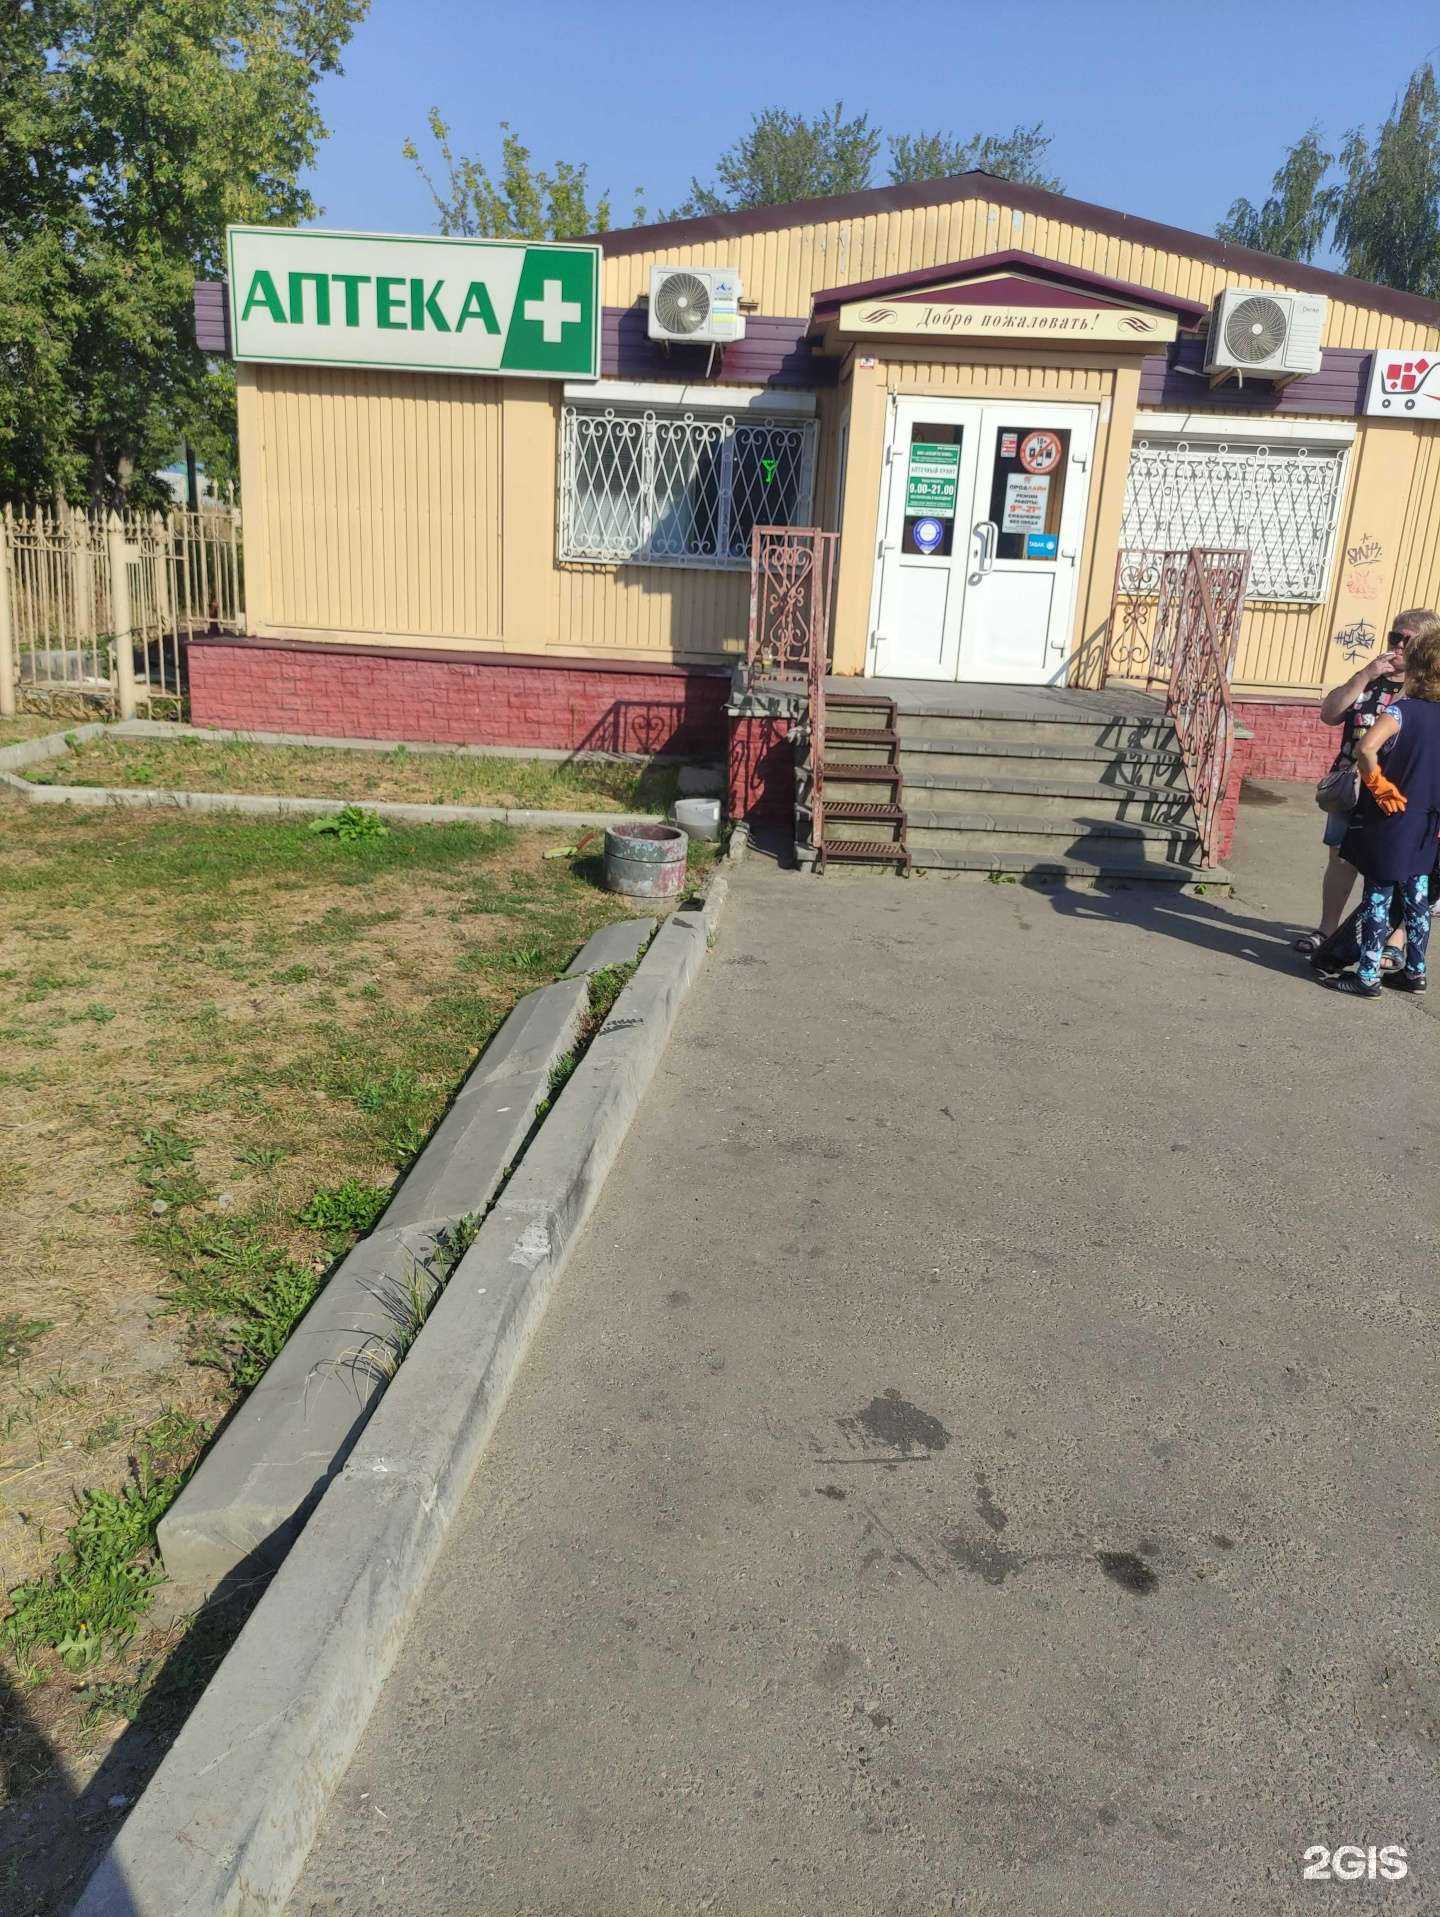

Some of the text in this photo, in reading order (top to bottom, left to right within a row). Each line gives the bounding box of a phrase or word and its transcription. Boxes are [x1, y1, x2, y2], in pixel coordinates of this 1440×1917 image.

[241, 269, 501, 336] АПТЕКА
[916, 307, 1099, 331] Добро пожаловать!
[909, 483, 954, 496] 9.00-21.00
